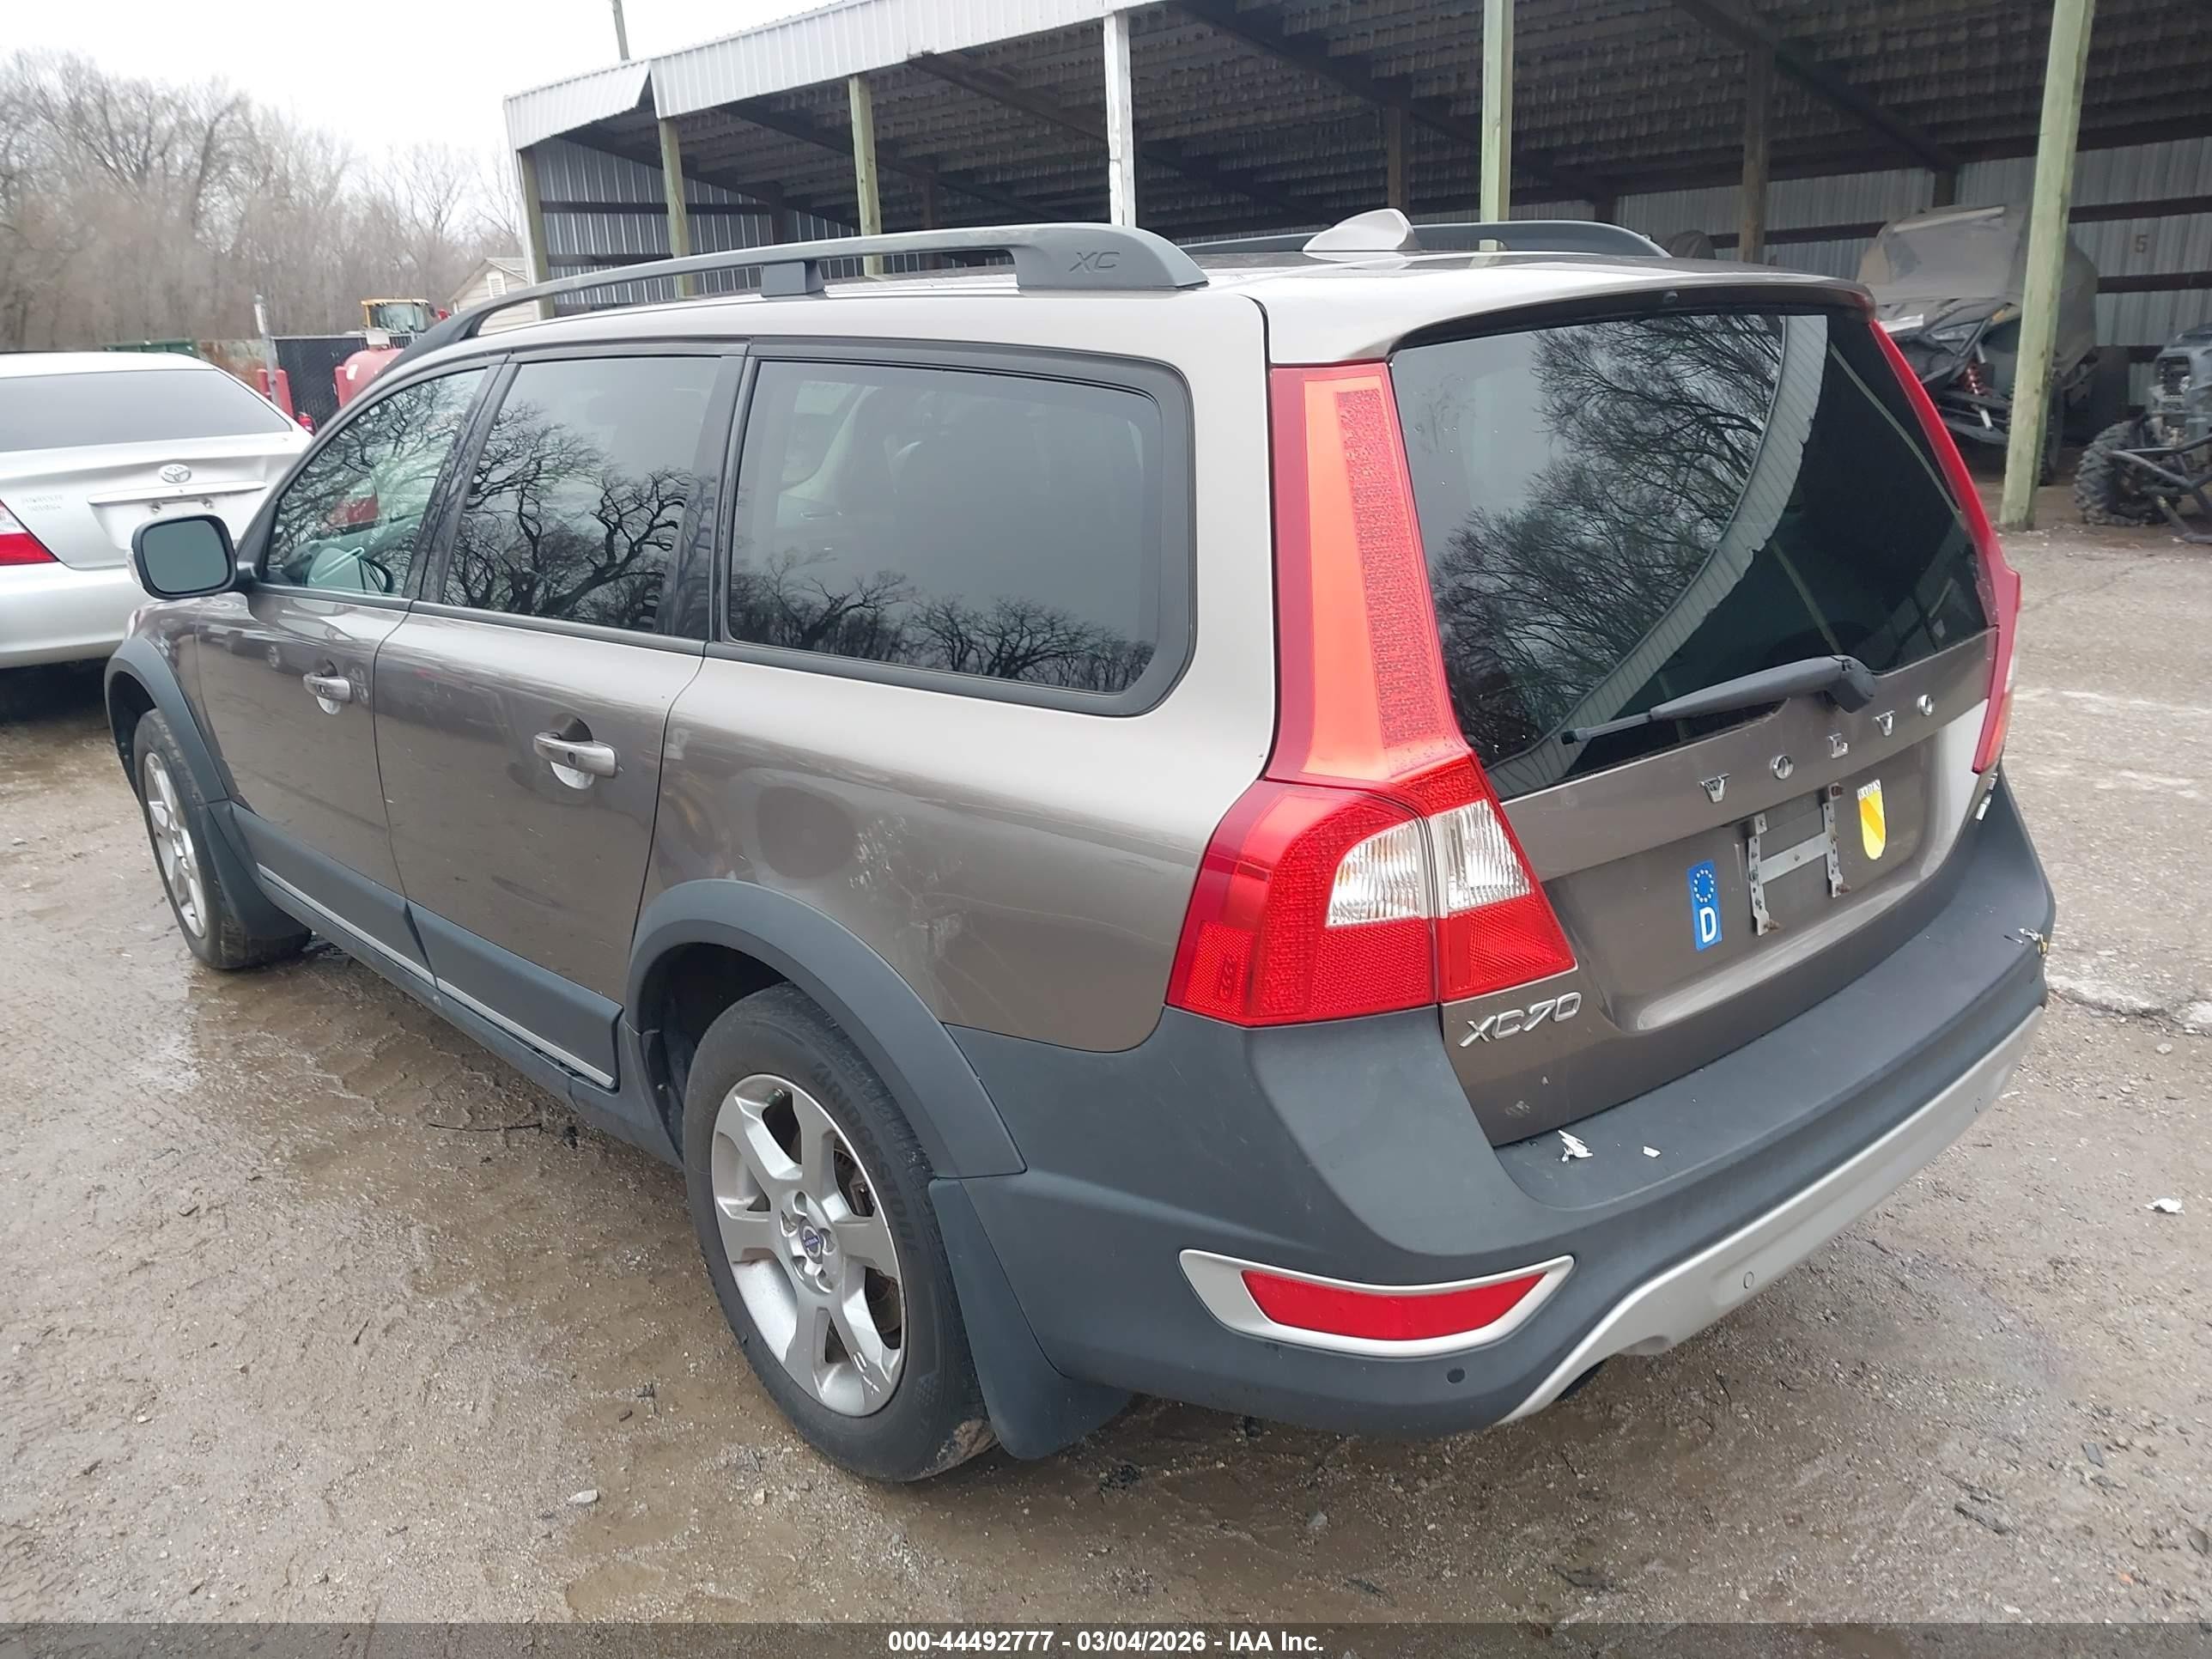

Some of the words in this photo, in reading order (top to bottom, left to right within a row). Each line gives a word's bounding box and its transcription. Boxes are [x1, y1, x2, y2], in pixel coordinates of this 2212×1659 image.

[1068, 251, 1121, 272] XC
[1698, 694, 1934, 803] VOLVO
[1699, 906, 1717, 944] D
[1458, 991, 1582, 1048] XC70
